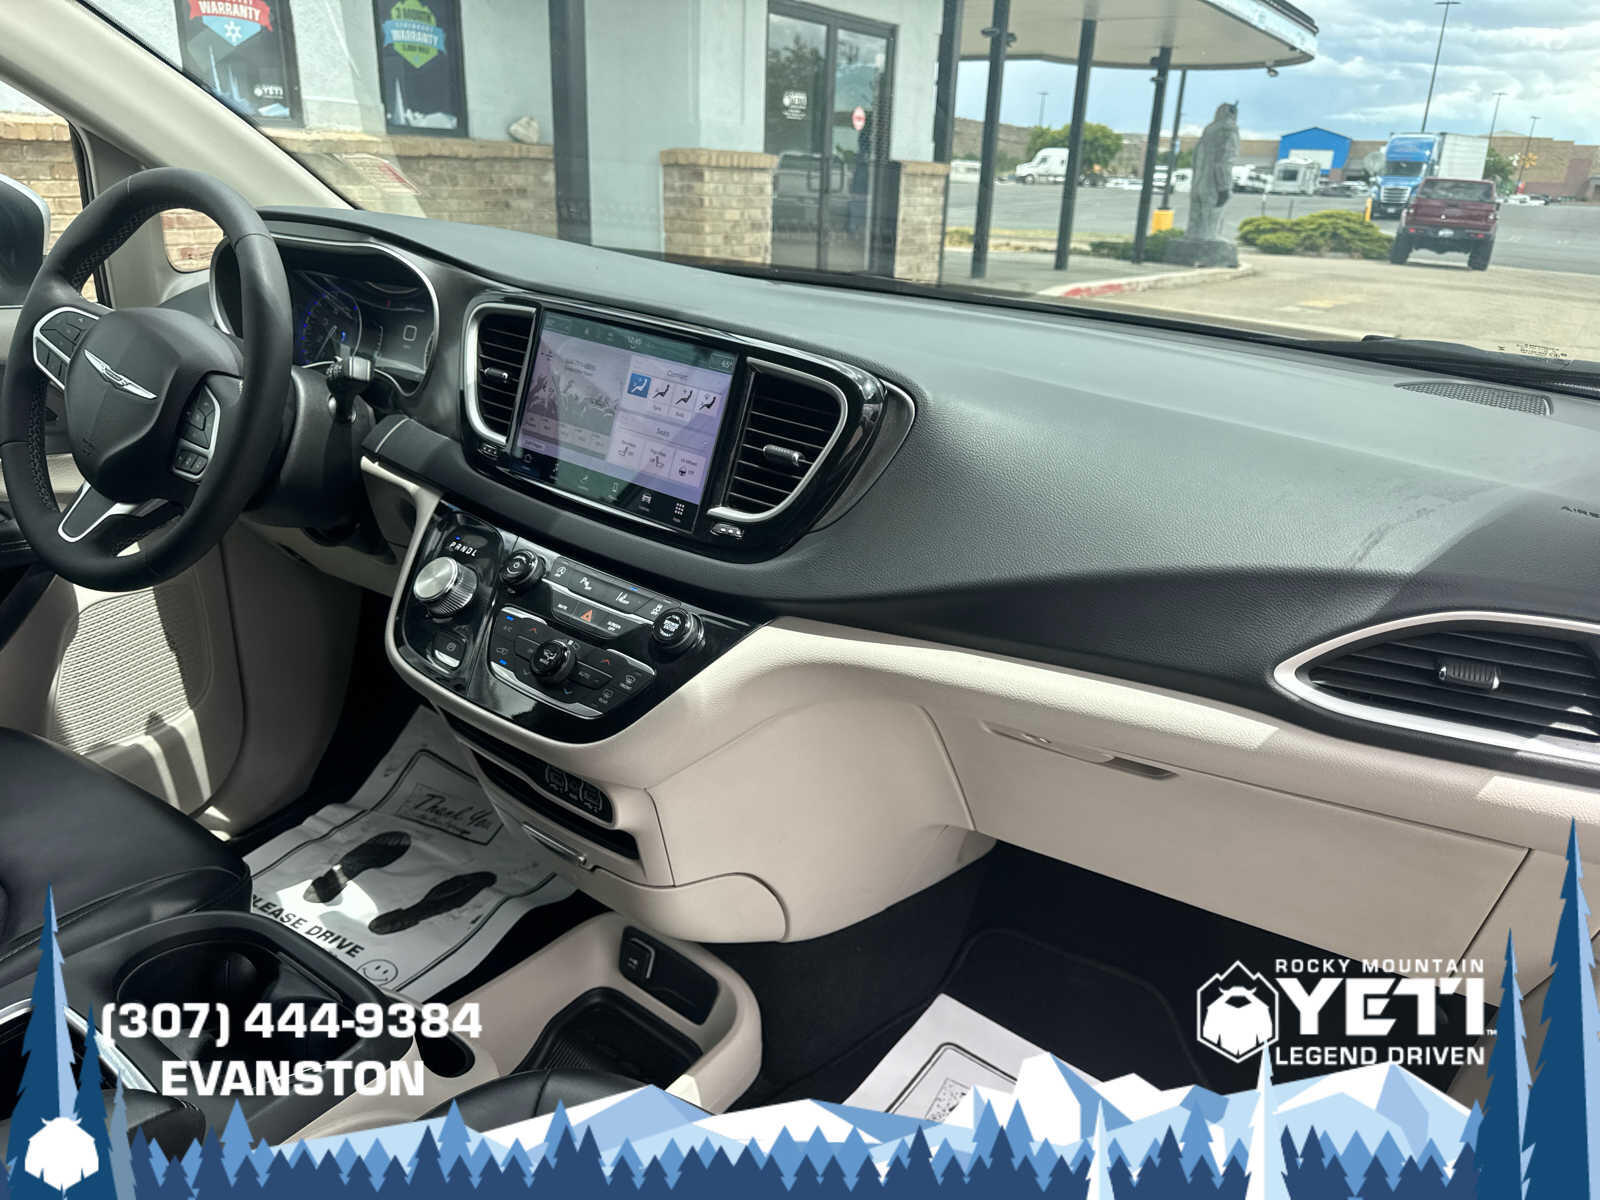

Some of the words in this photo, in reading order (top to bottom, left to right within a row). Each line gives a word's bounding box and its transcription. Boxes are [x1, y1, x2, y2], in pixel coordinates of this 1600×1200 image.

[198, 0, 260, 21] WARRANTY
[391, 29, 439, 46] WARRANTY
[262, 84, 284, 96] YETI
[305, 925, 365, 958] DRIVE
